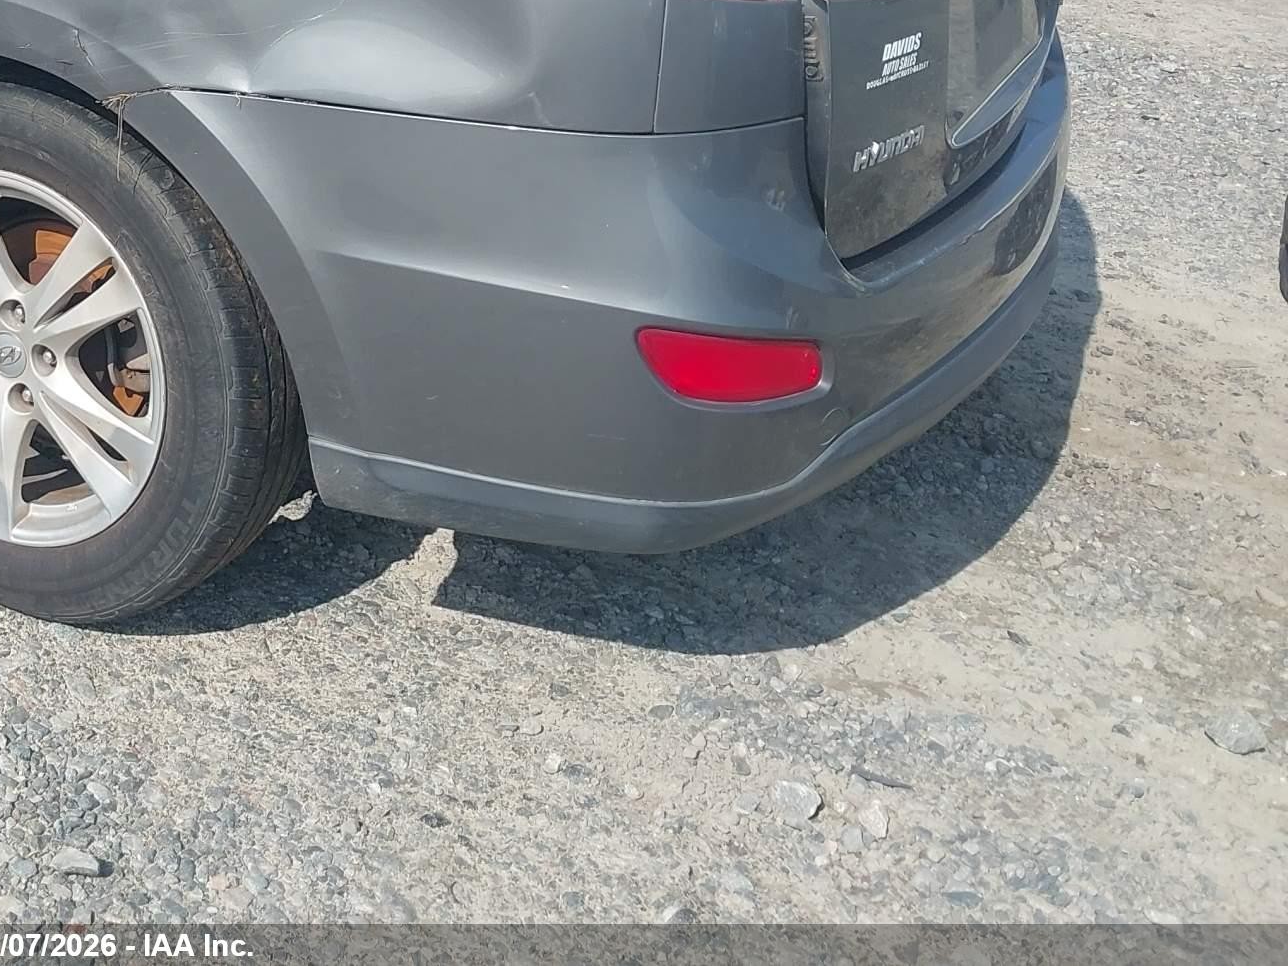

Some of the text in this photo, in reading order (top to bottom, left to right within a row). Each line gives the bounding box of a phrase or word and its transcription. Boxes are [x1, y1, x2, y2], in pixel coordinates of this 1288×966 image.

[882, 32, 922, 62] DAVIDS
[882, 51, 918, 77] AUTO SALES
[853, 125, 925, 172] HYUNDAI
